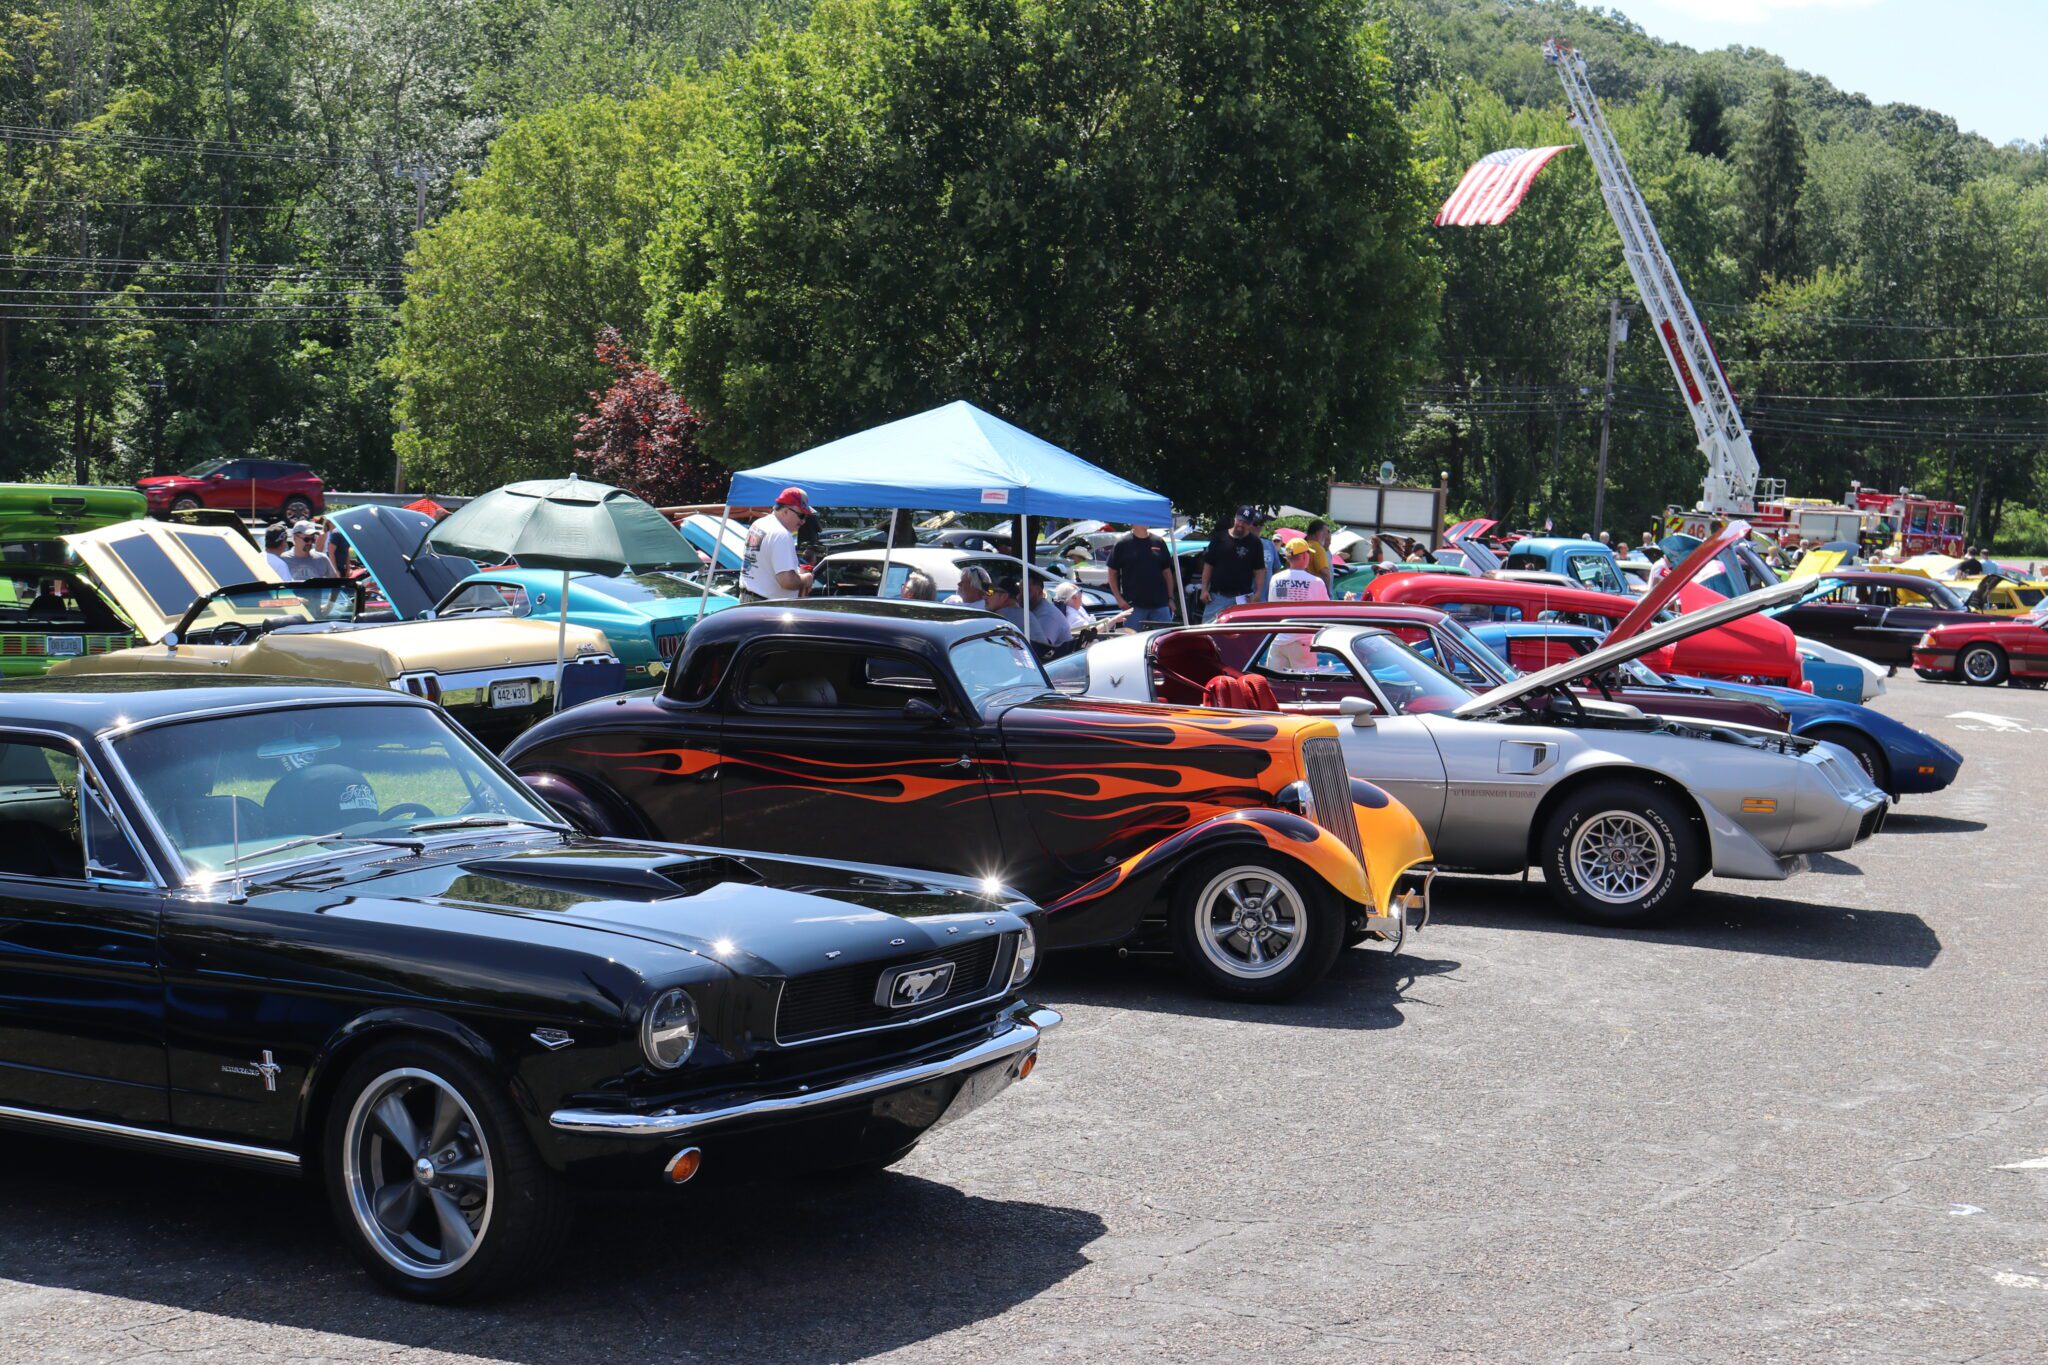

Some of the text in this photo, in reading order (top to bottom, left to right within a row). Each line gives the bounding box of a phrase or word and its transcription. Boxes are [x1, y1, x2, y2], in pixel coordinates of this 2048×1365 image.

[1670, 338, 1694, 387] OXFORD
[1688, 523, 1706, 539] 46
[1558, 812, 1580, 895] RADIAL G/T
[1642, 808, 1678, 909] COOPER COBRA
